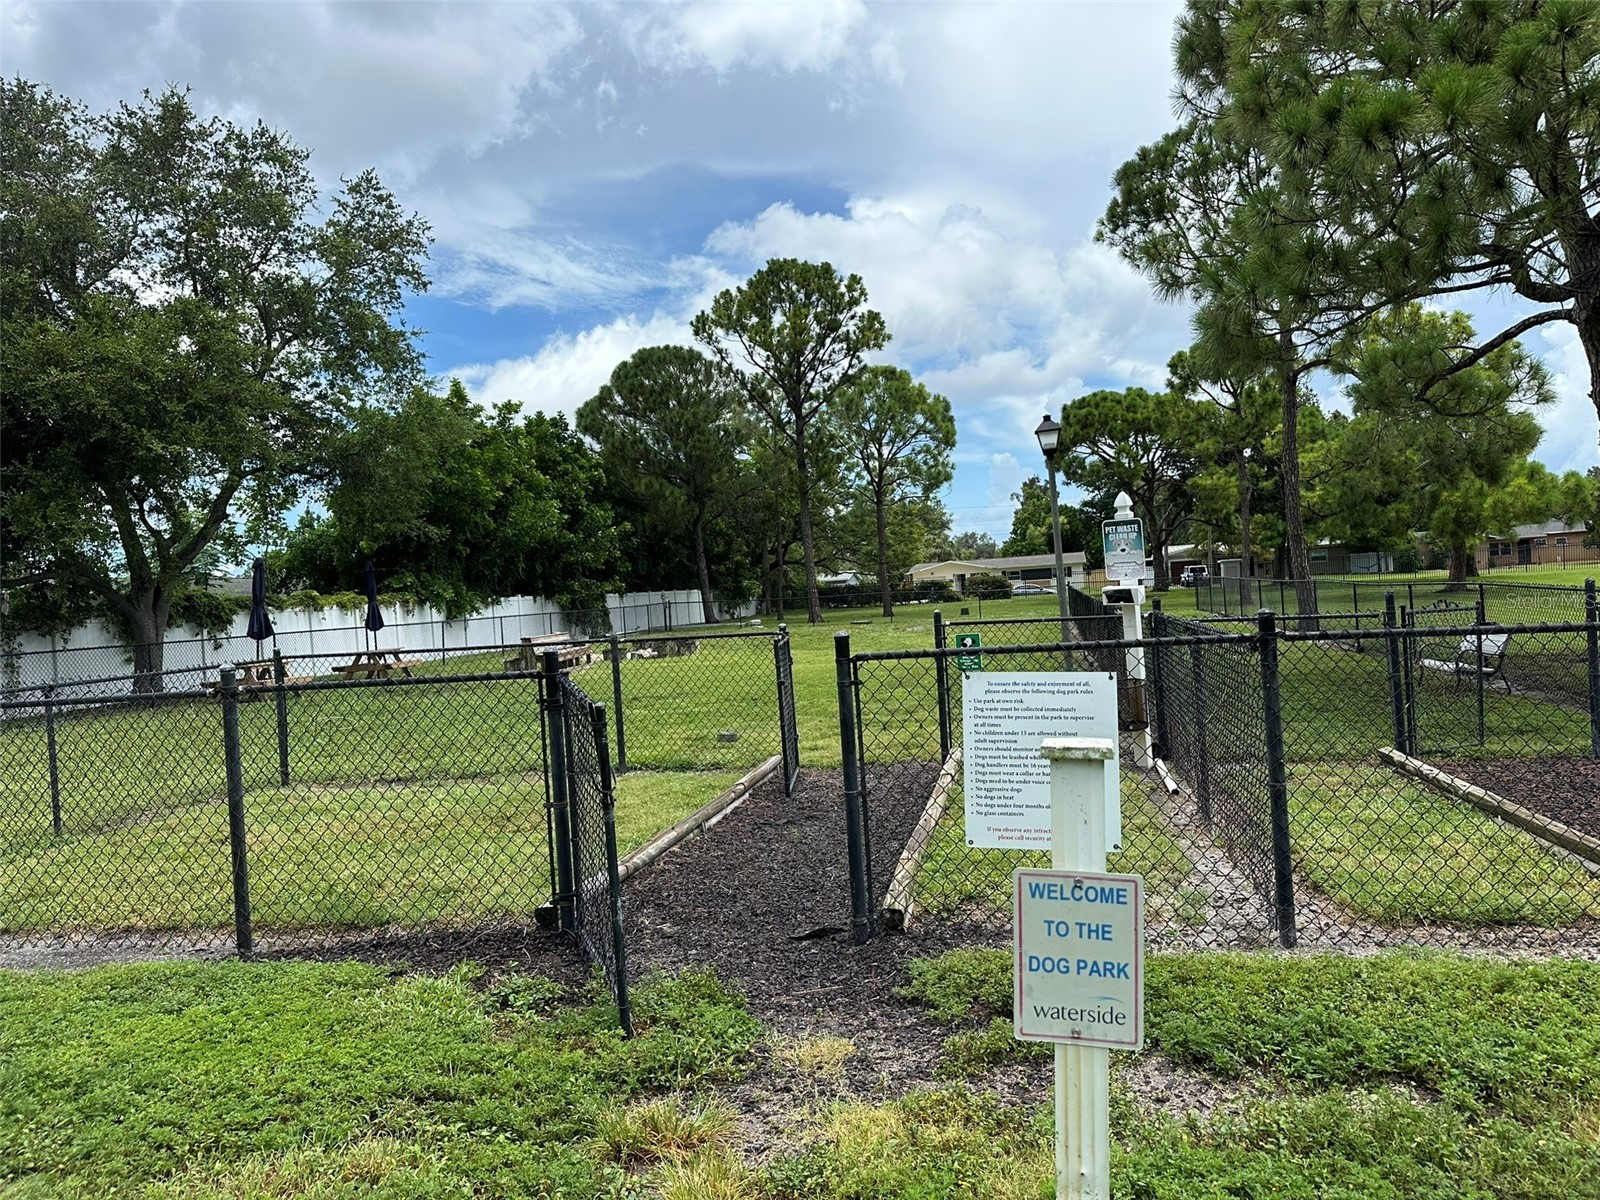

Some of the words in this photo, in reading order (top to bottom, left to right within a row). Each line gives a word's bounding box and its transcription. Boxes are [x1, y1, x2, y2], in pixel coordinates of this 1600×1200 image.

[1105, 526, 1116, 534] PET
[1109, 533, 1127, 541] CLEAN
[1029, 883, 1127, 905] WELCOME
[1044, 920, 1070, 937] TO
[1075, 922, 1113, 941] THE
[1029, 956, 1070, 974] DOG
[1077, 960, 1130, 979] PARK
[1034, 1005, 1126, 1025] waterside
